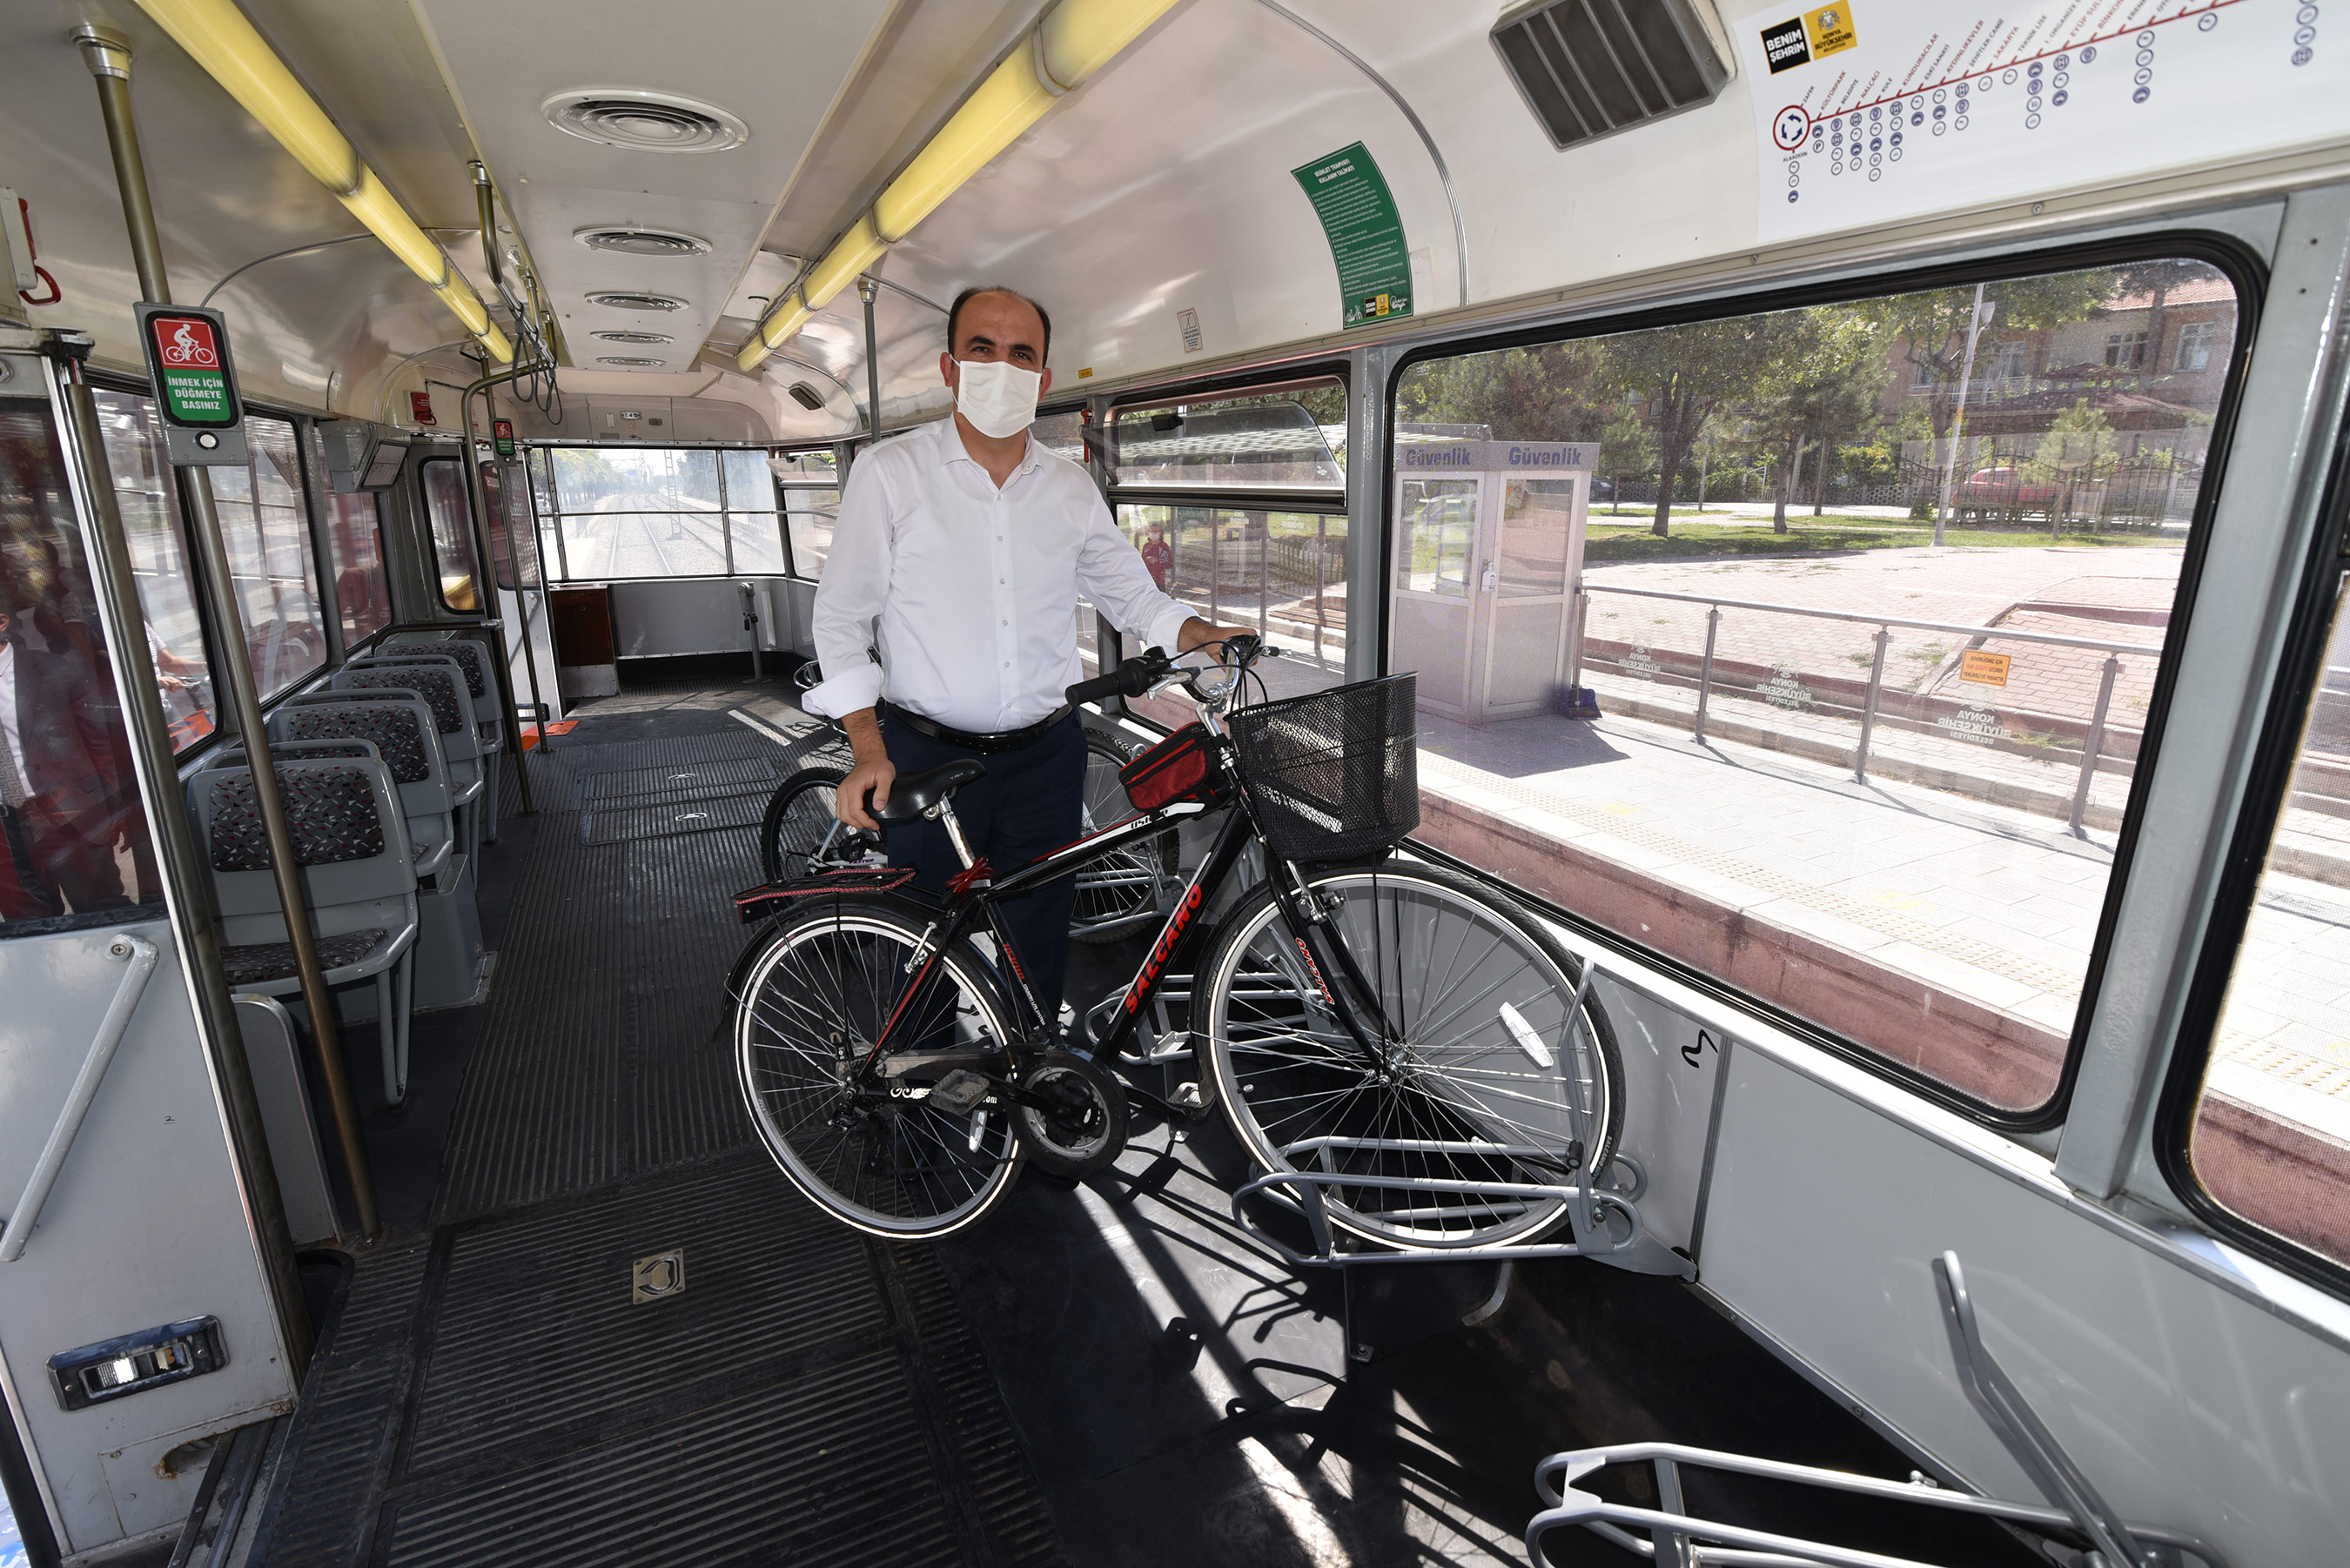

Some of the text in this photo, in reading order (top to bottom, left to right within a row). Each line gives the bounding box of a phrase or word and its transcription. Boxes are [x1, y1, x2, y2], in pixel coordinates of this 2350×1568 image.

[1766, 29, 1803, 52] BENİM
[1823, 30, 1842, 39] KONYA
[1993, 26, 2019, 59] SAKARYA
[1769, 42, 1805, 64] ŞEHRİM
[1946, 19, 1984, 73] AYDINLIKEVLER
[1903, 33, 1939, 87] KUNDURACILAR
[1803, 85, 1815, 104] ZAFER
[1821, 70, 1847, 111] KÜLTÜRPARK
[1861, 70, 1881, 98] NALÇACI
[1882, 77, 1892, 93] KULE
[167, 376, 223, 389] İNMEK İÇİN
[176, 387, 221, 399] DÜĞMEYE
[182, 400, 220, 410] BASINIZ
[1406, 447, 1471, 466] Güvenlik
[1509, 446, 1581, 466] Güvenlik
[1125, 883, 1203, 1015] SALCANO
[1295, 938, 1335, 1006] SALCANO
[1599, 1135, 1612, 1166] SALCANO
